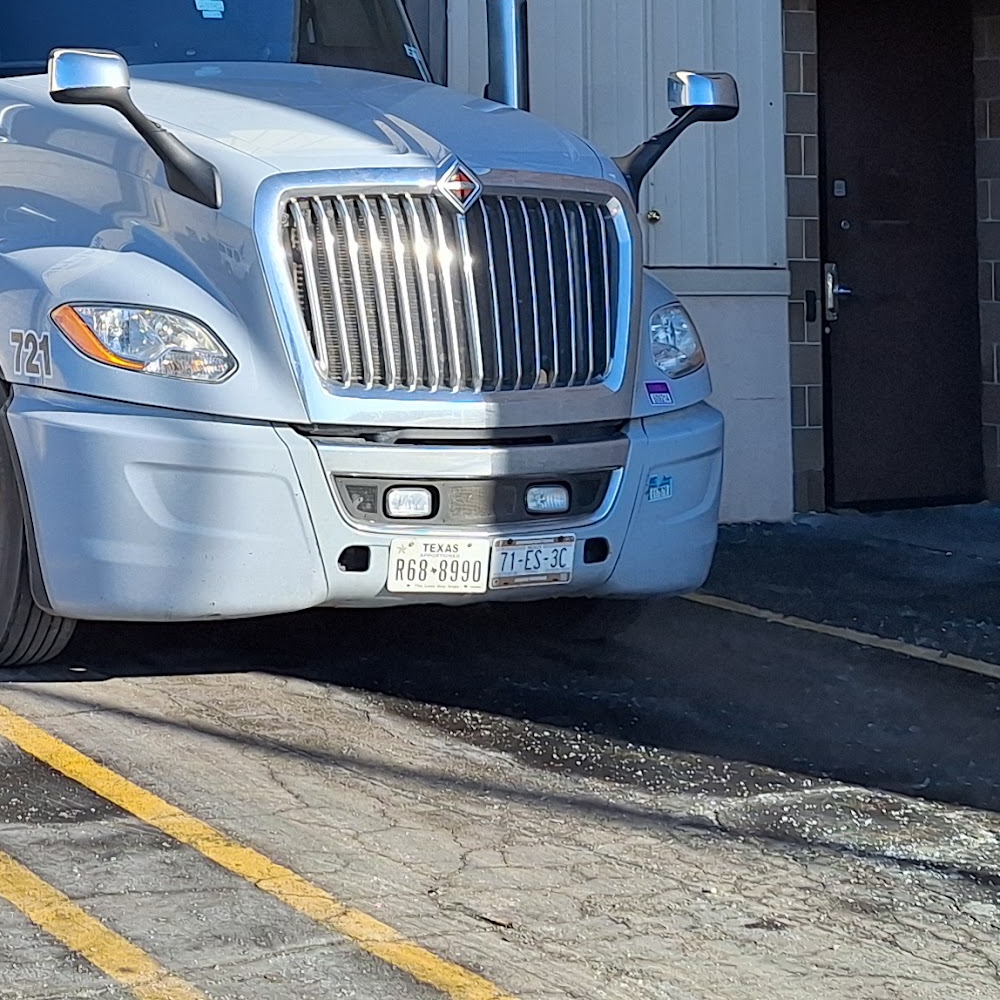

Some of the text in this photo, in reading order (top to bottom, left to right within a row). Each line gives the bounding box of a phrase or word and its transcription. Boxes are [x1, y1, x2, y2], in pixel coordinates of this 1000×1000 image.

[9, 328, 53, 379] 721
[423, 543, 459, 553] TEXAS
[501, 547, 567, 572] 71-ES-3C
